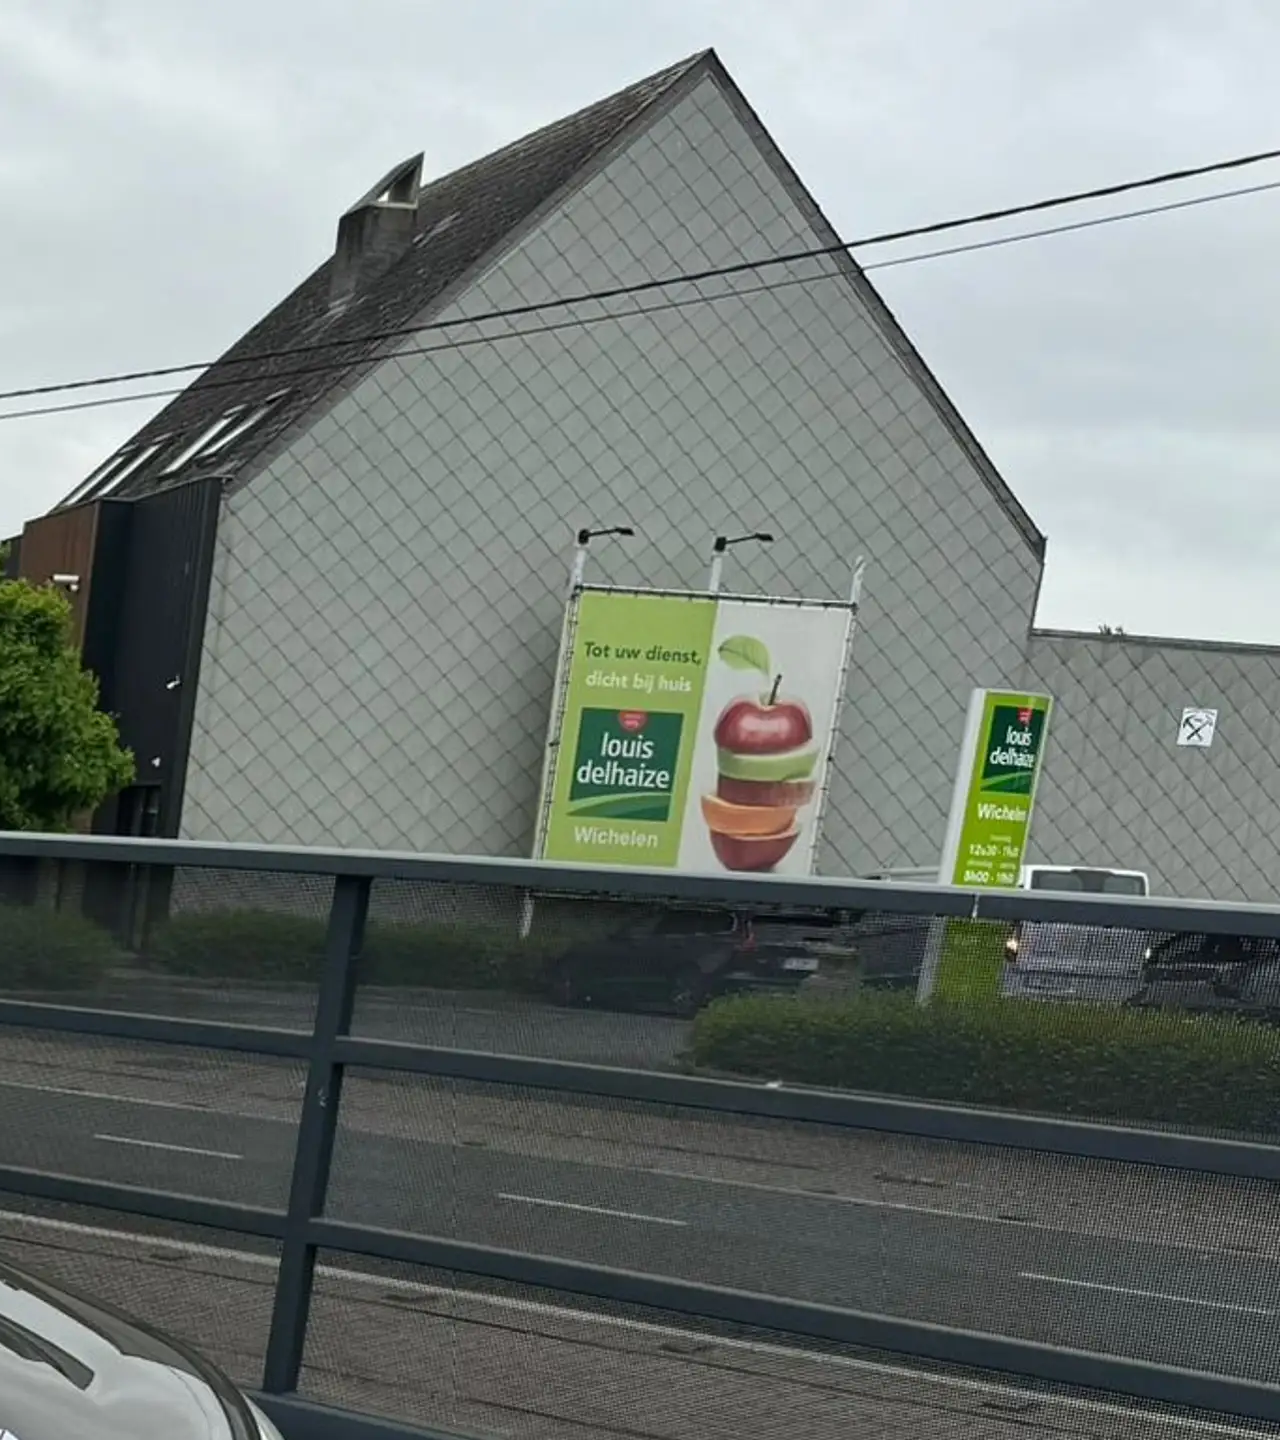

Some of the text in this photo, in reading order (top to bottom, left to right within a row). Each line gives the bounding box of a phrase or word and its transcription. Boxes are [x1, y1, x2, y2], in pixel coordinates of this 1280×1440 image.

[584, 641, 702, 665] Tot uw dienst,
[585, 670, 692, 694] dicht bij huis
[600, 731, 655, 759] louis
[1005, 724, 1033, 746] louis
[576, 759, 670, 789] delhaize
[574, 825, 659, 848] Wichelen
